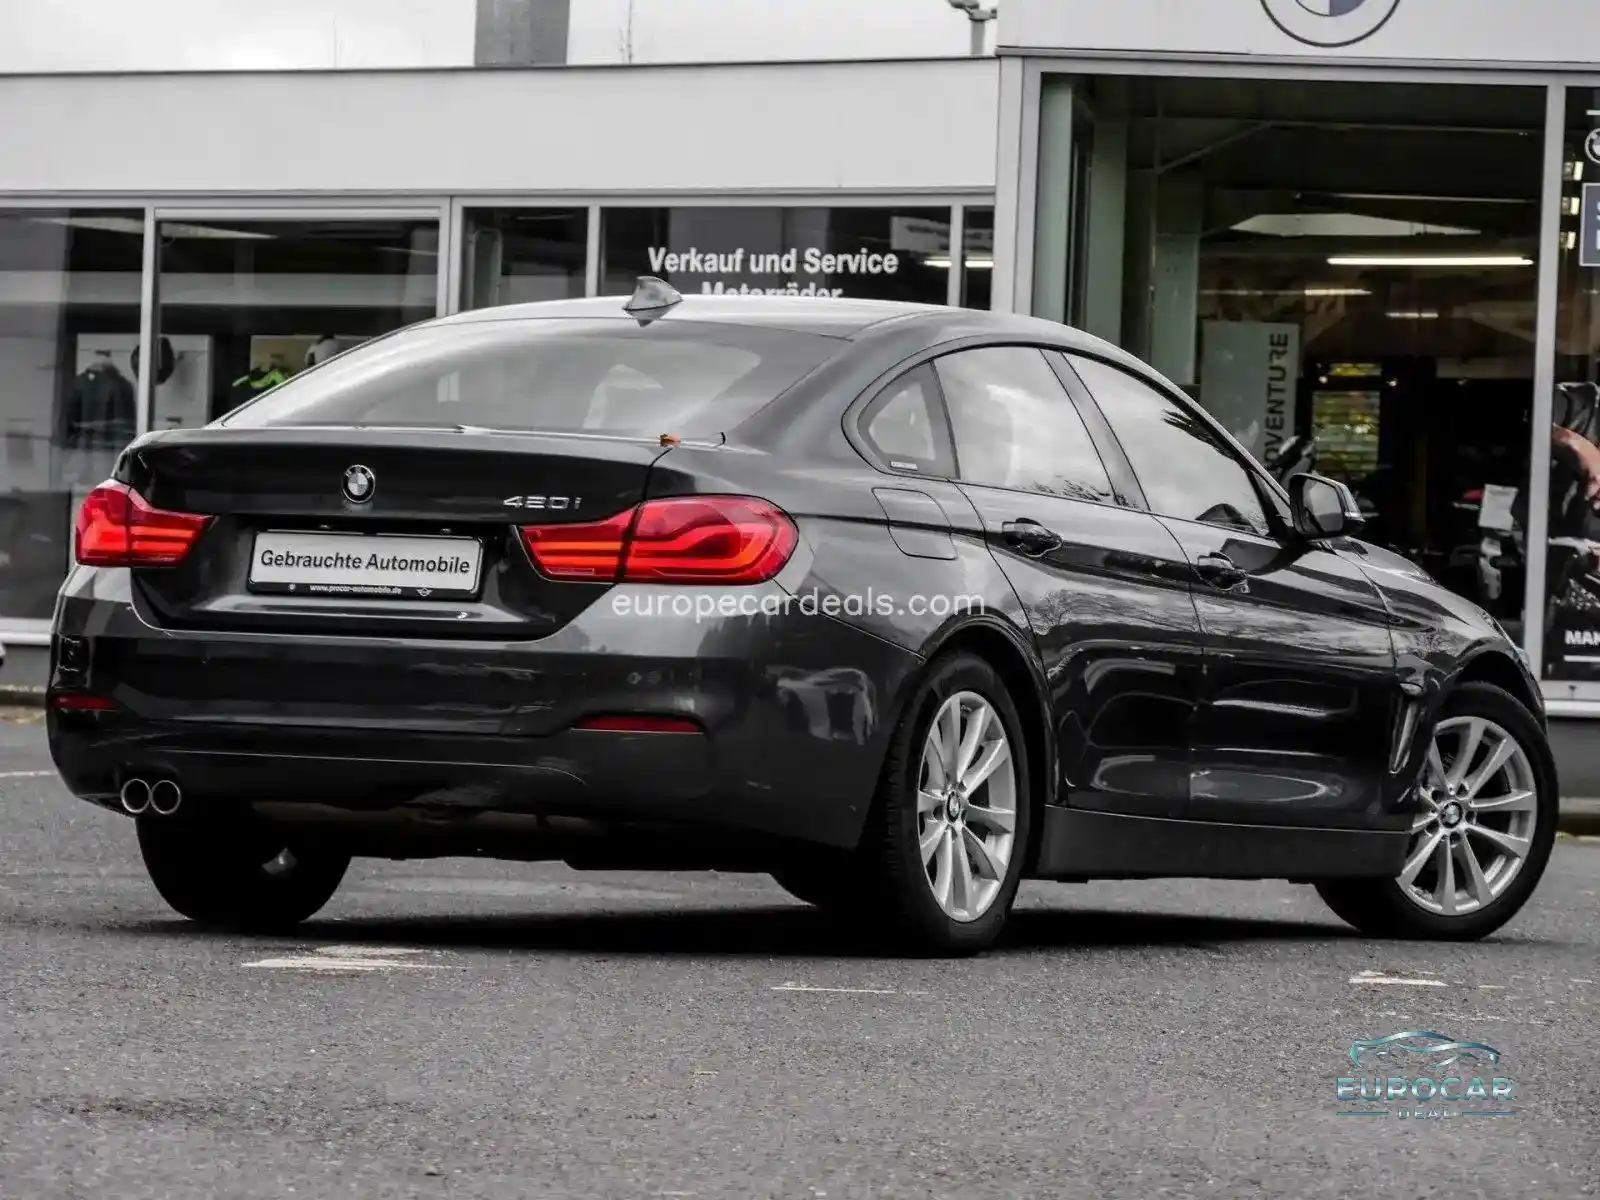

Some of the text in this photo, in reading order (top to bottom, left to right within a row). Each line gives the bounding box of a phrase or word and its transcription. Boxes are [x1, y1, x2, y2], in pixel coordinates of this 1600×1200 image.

[648, 247, 899, 274] Verkauf und Service
[1264, 333, 1288, 470] DVENTURE
[503, 496, 582, 510] 420i
[260, 549, 470, 574] Gebrauchte Automobile
